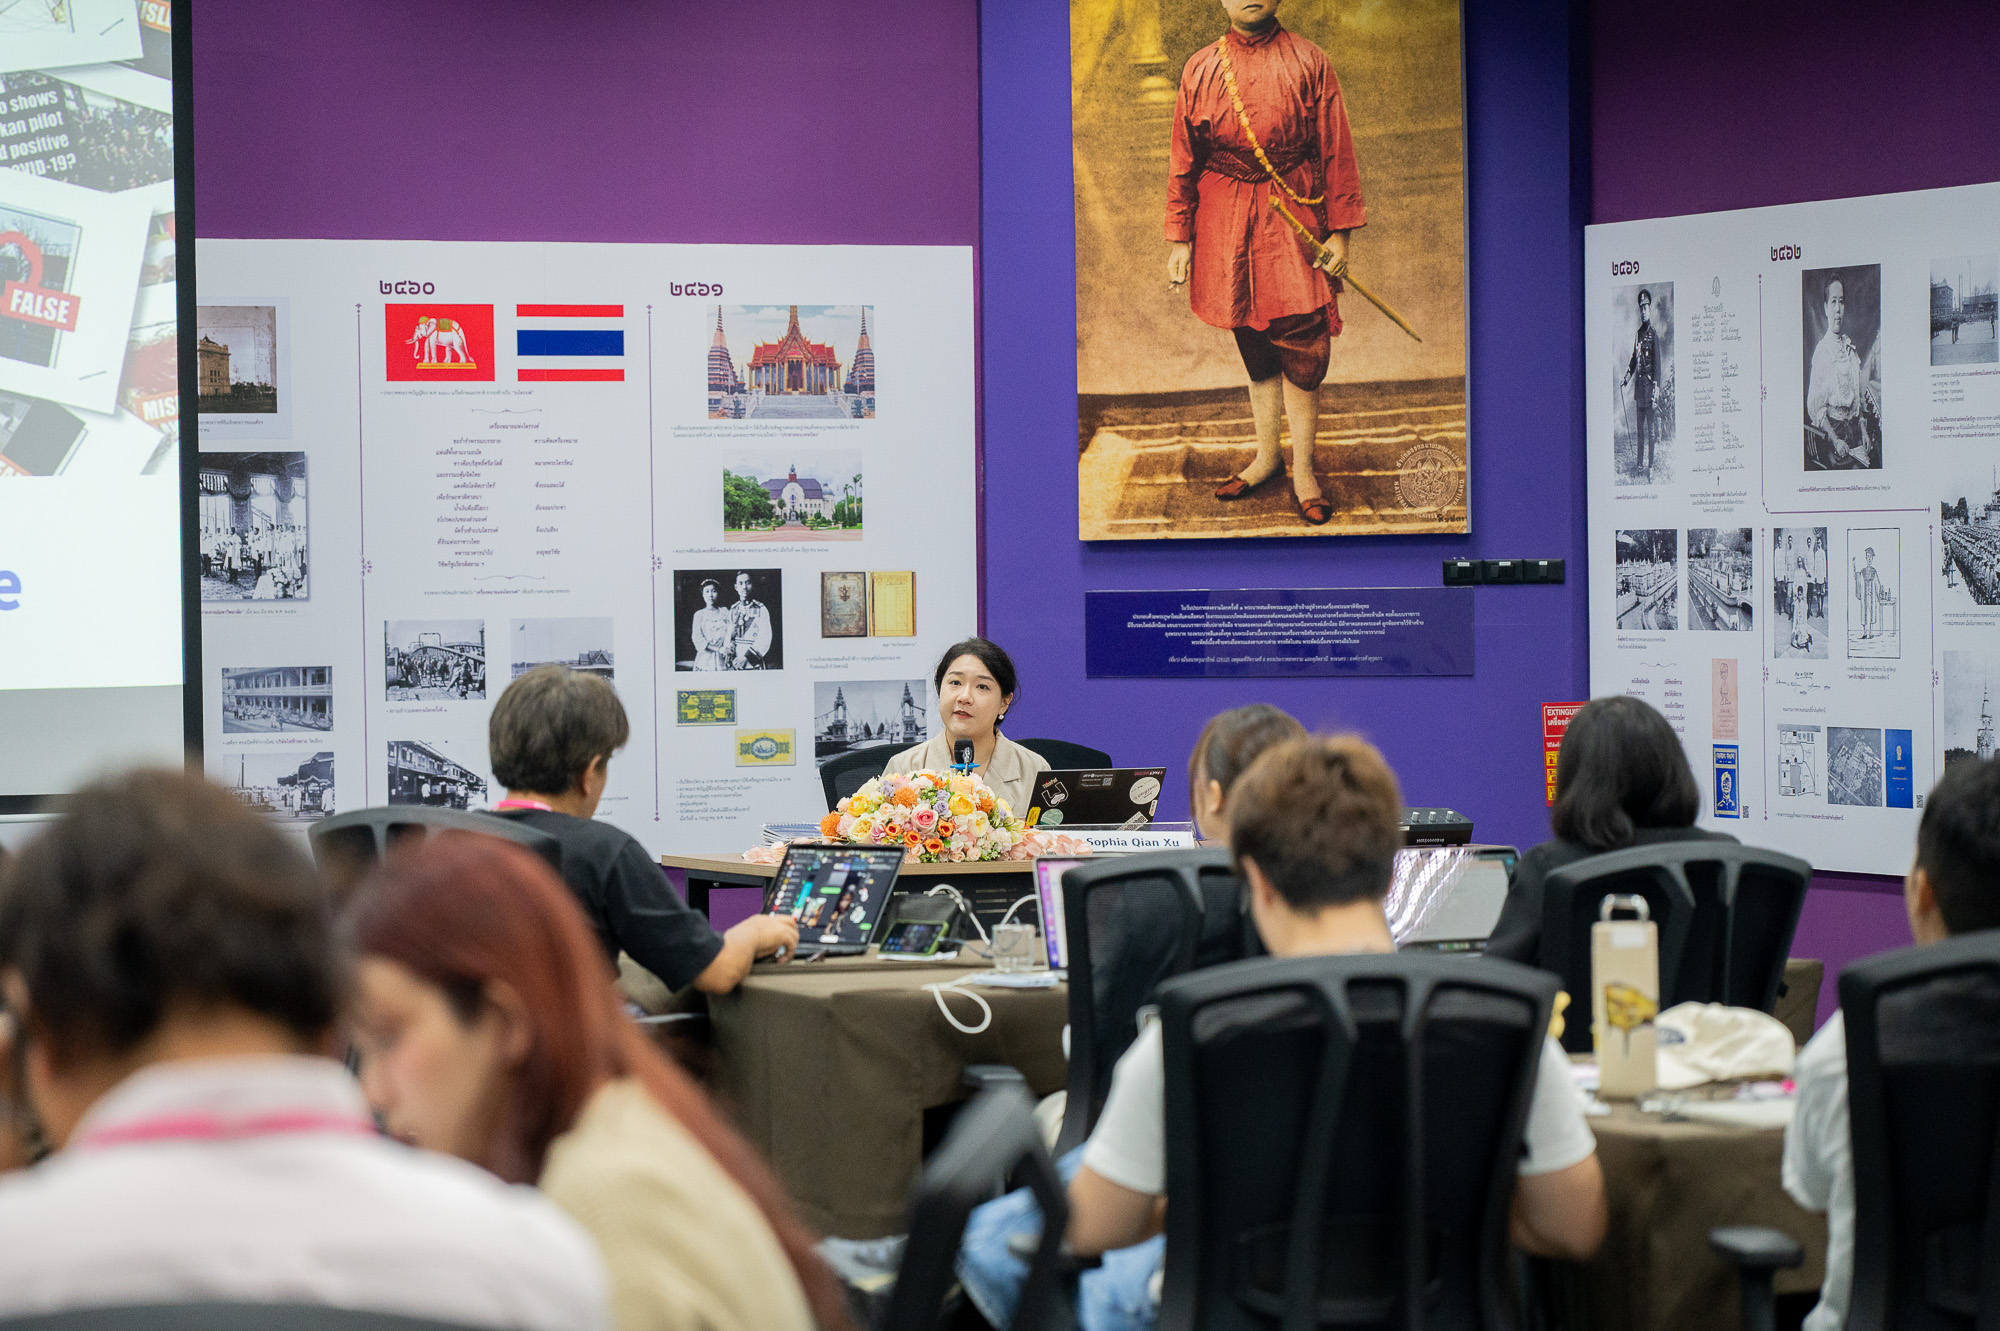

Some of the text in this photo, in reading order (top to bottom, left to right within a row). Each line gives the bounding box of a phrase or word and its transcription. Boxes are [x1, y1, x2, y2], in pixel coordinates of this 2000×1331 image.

[9, 90, 58, 112] shows
[28, 111, 64, 133] pilot
[9, 134, 69, 159] positive
[1770, 244, 1801, 262] ๒๔๖๒
[379, 279, 435, 295] ๒๔๖๐
[670, 281, 723, 296] ๒๔๖๑
[10, 288, 71, 324] FALSE
[0, 570, 22, 611] e
[1547, 708, 1580, 716] EXTINGUIS
[1086, 837, 1180, 848] Sophia Qian Xu
